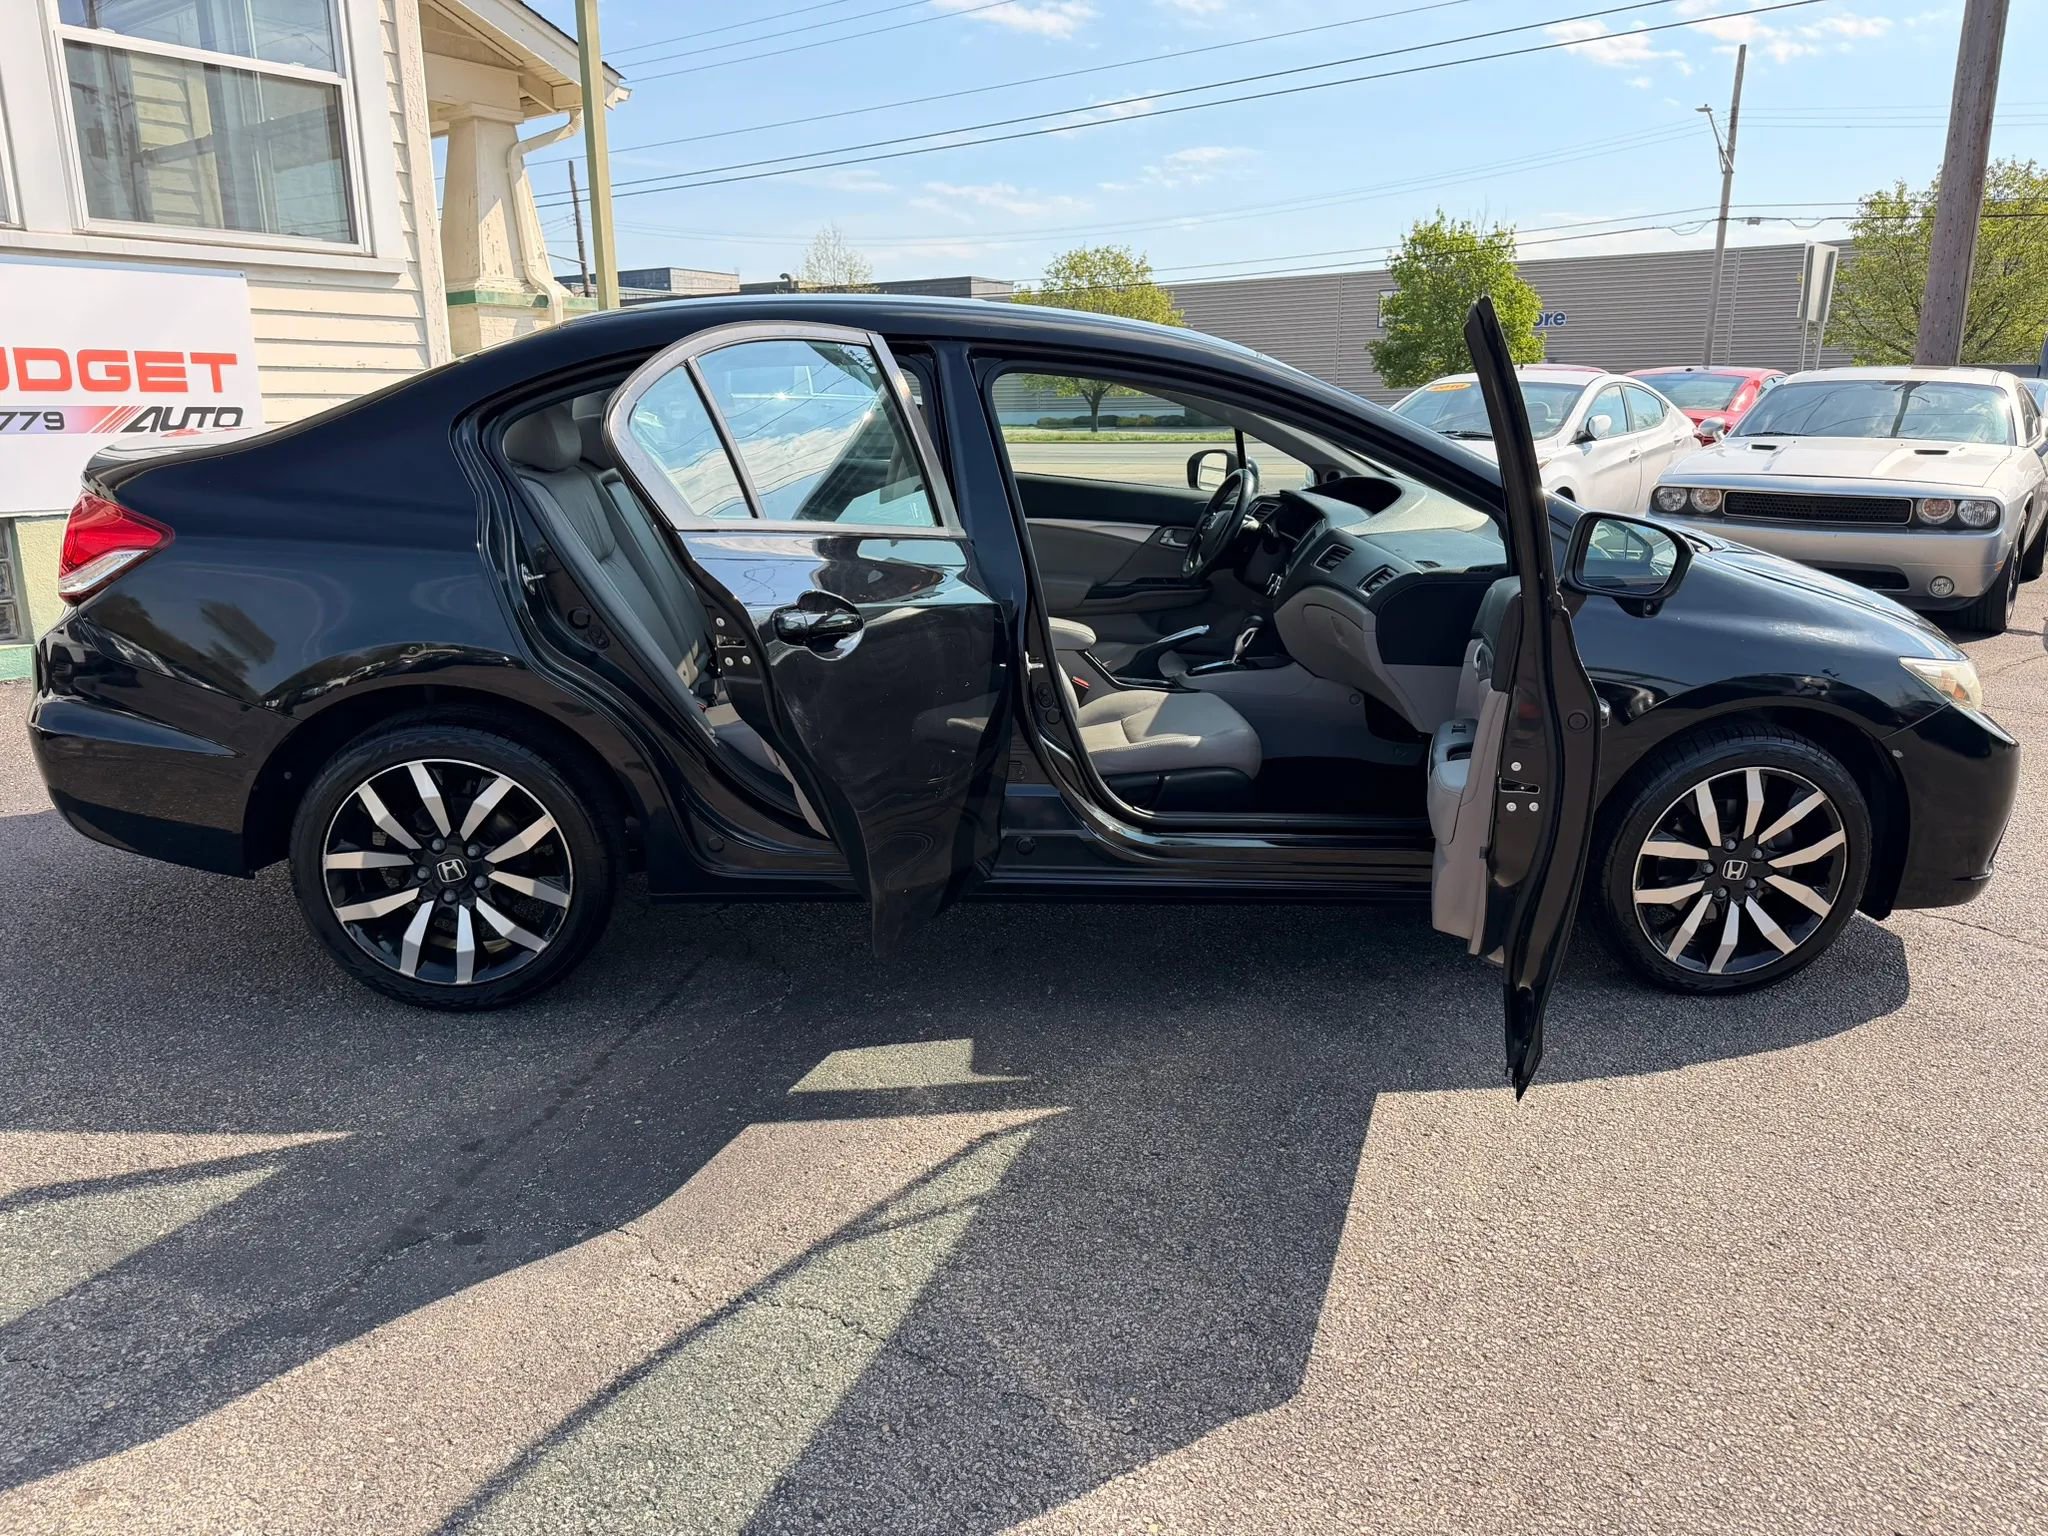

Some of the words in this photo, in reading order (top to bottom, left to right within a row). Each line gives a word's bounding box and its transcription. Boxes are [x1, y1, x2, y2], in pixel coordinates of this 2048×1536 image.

[0, 346, 238, 393] DGET
[0, 411, 65, 431] 779
[121, 406, 243, 433] AUTO
